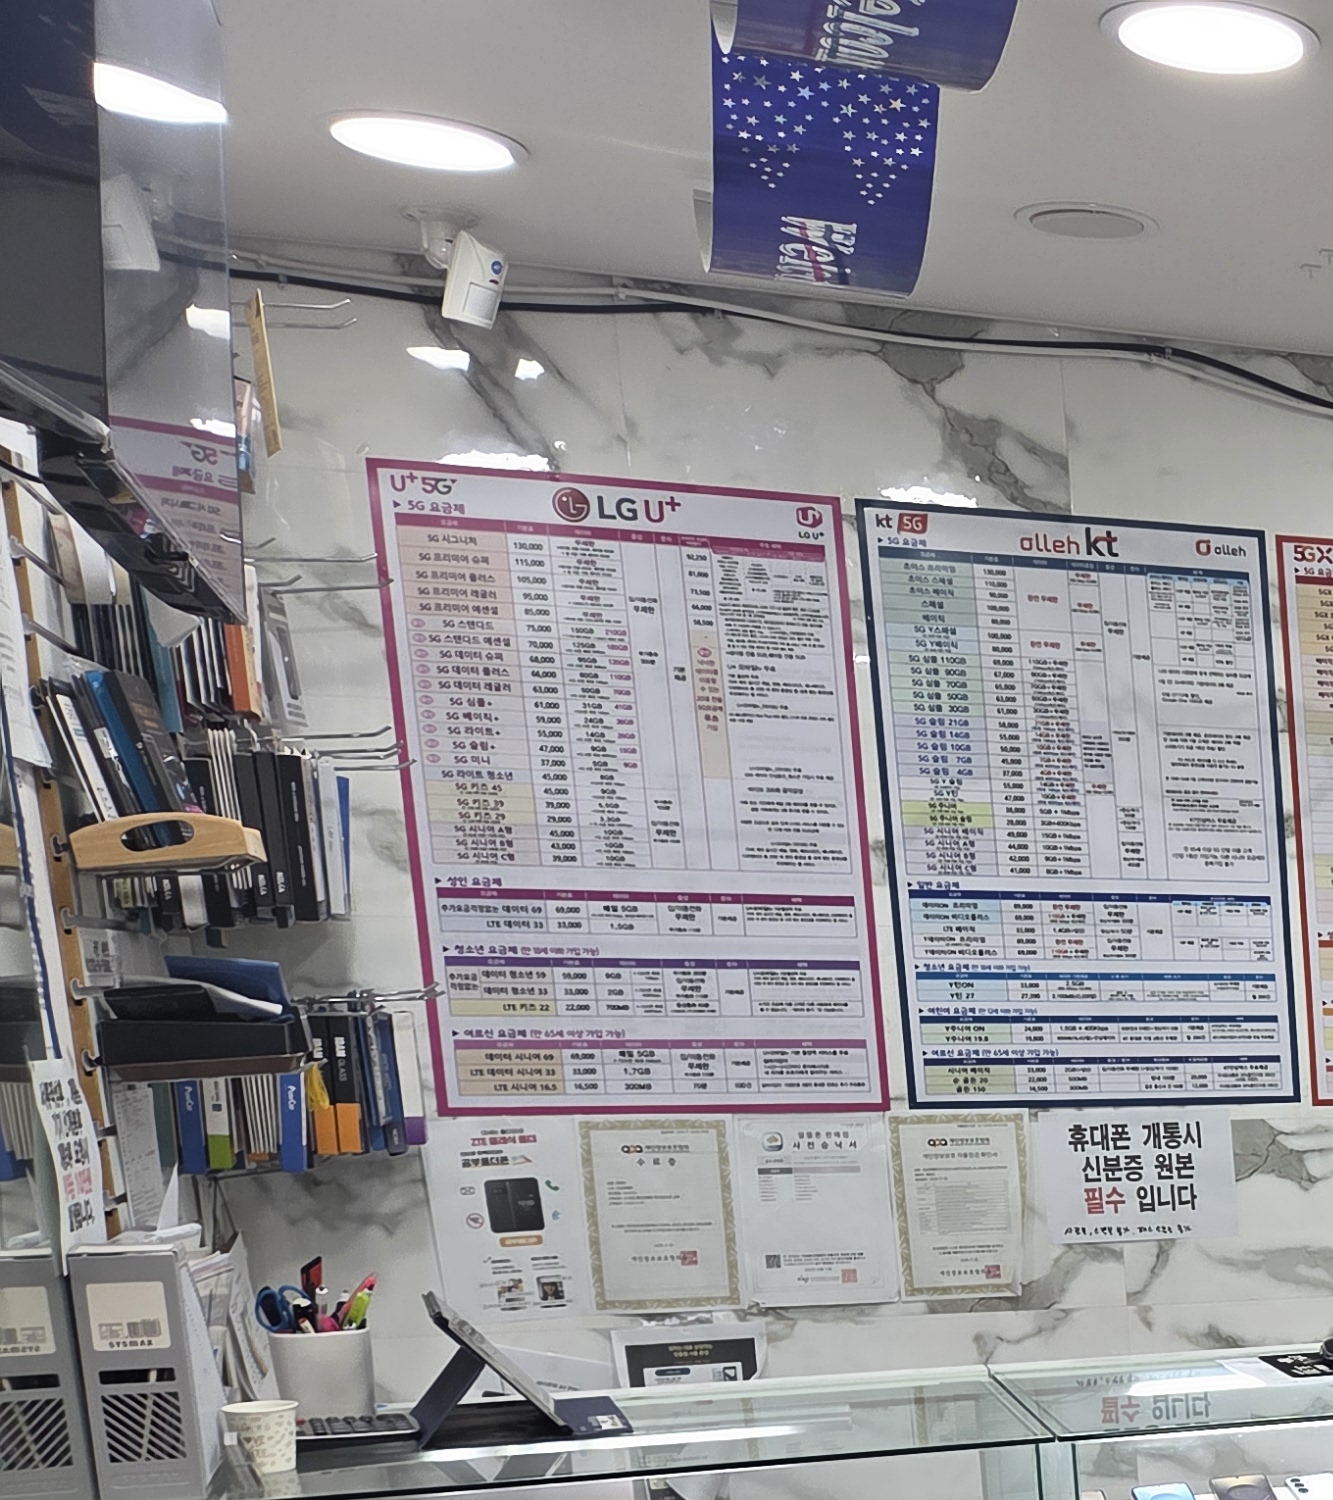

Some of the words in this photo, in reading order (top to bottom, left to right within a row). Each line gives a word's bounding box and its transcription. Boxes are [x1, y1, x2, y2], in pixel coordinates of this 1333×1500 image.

[407, 500, 425, 511] 5G
[429, 502, 465, 514] 요금제
[597, 495, 638, 521] LG
[644, 496, 681, 524] U+
[875, 514, 892, 530] kt
[902, 515, 923, 531] 5G
[1020, 533, 1080, 556] olleh
[1085, 527, 1119, 558] kt
[1214, 544, 1247, 557] olleh
[1294, 545, 1333, 565] 5GX
[1068, 1123, 1131, 1152] 휴대폰
[1142, 1121, 1202, 1149] 개통시
[1082, 1154, 1144, 1183] 신분증
[1154, 1153, 1195, 1181] 원본
[1084, 1186, 1126, 1215] 필수
[1136, 1183, 1197, 1212] 입니다
